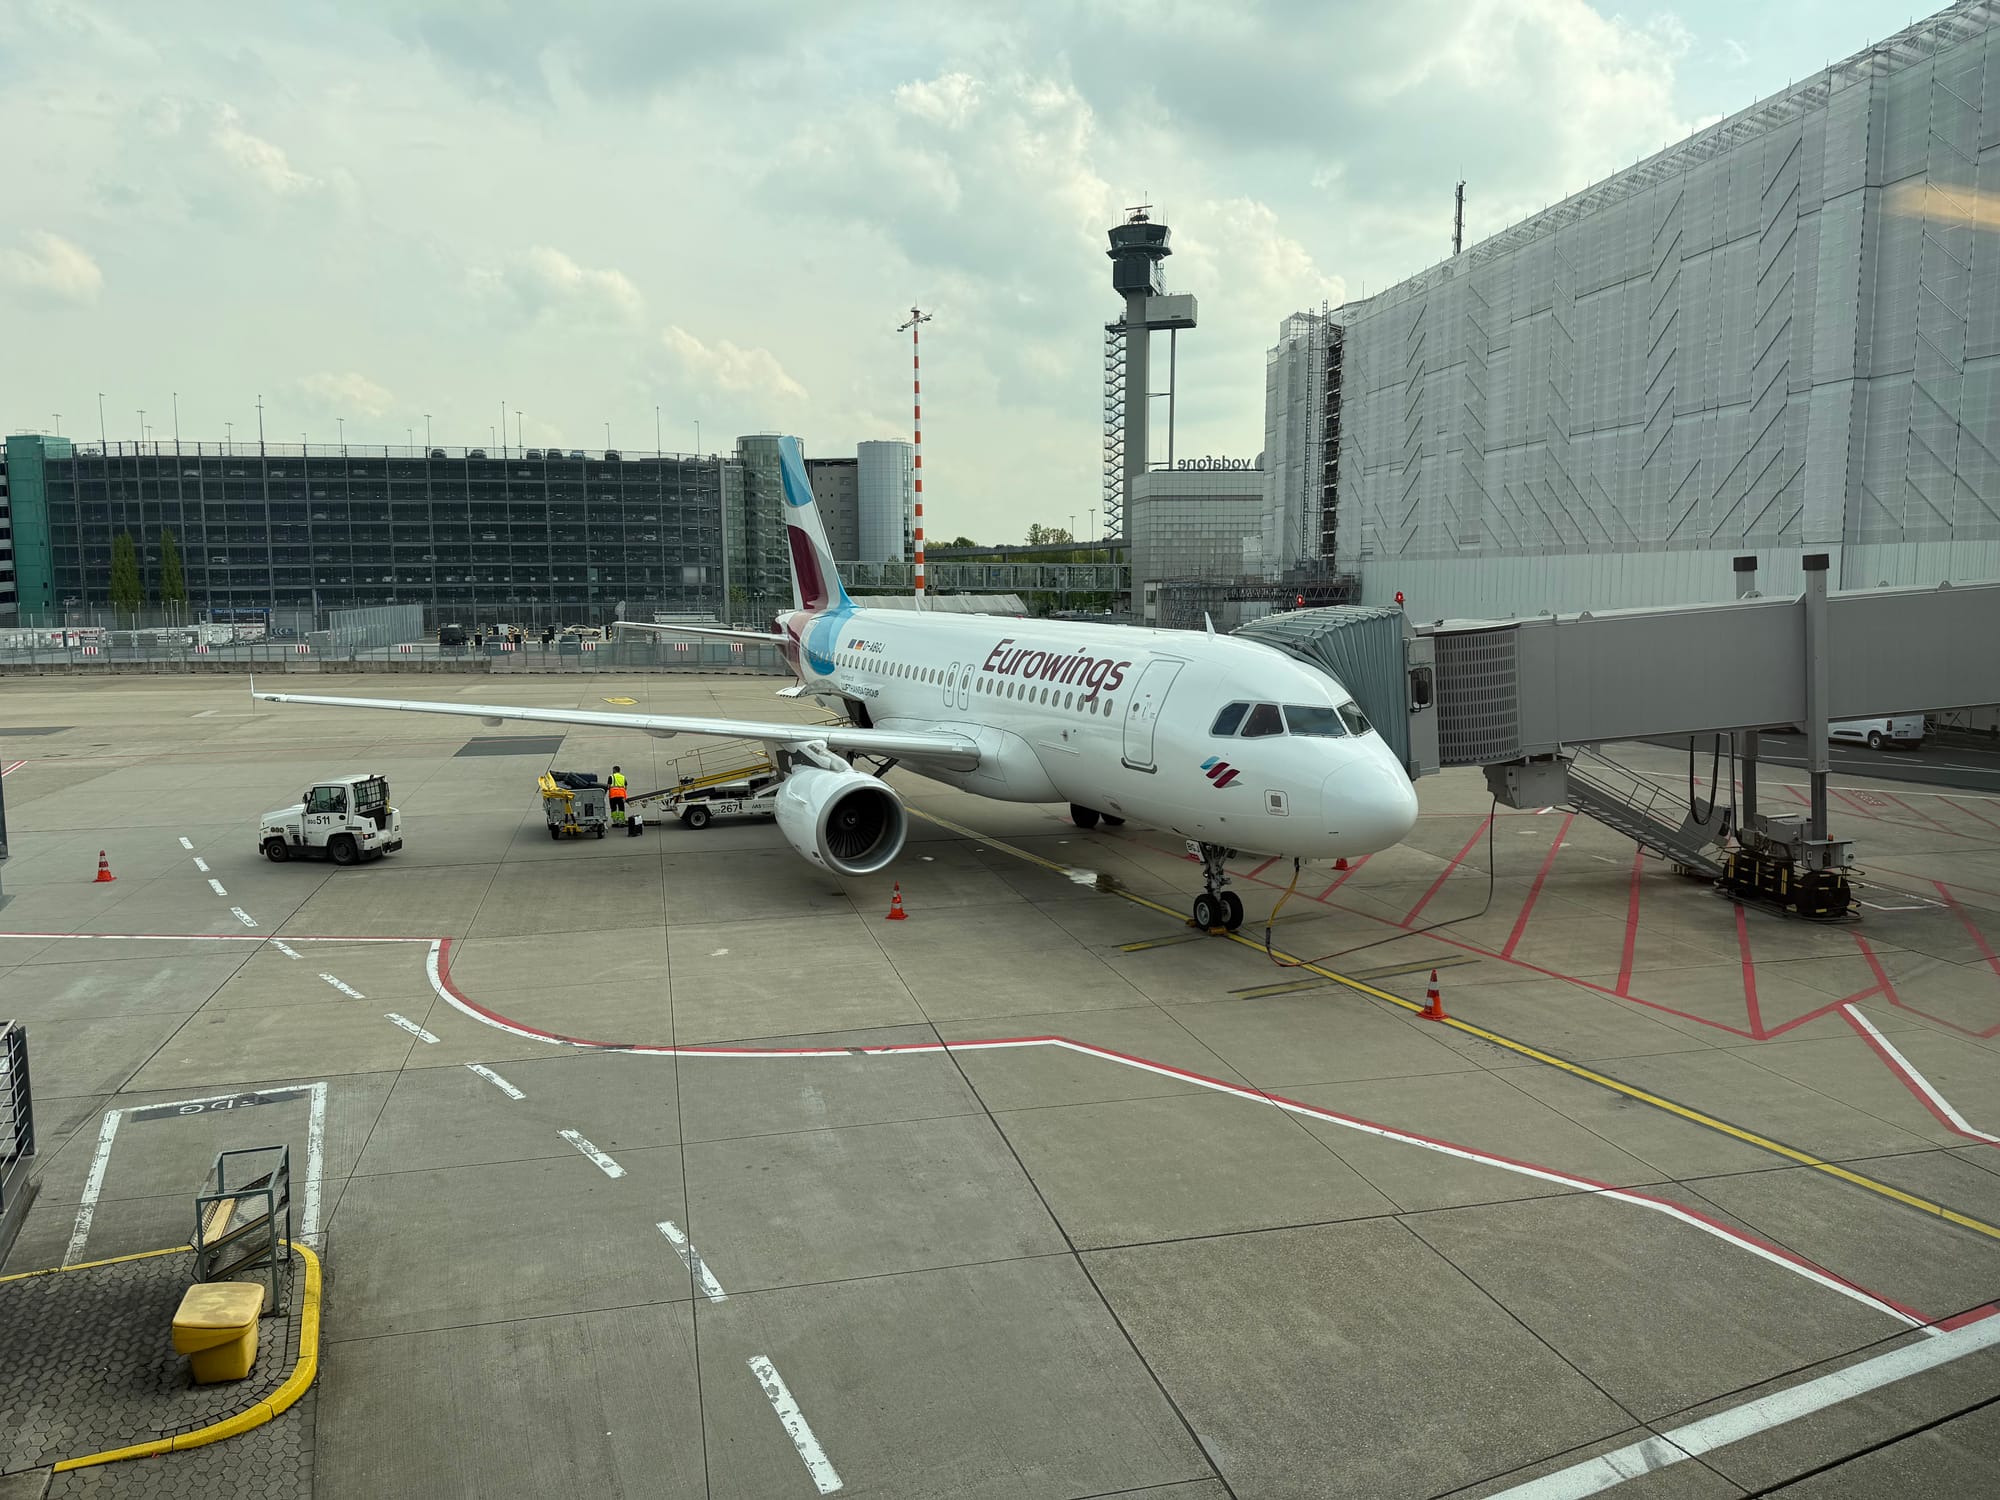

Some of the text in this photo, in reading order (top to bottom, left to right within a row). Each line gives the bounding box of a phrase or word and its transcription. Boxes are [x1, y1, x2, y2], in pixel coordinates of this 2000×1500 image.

[983, 639, 1132, 702] Eurowings
[720, 804, 738, 814] 267
[316, 815, 331, 825] 511
